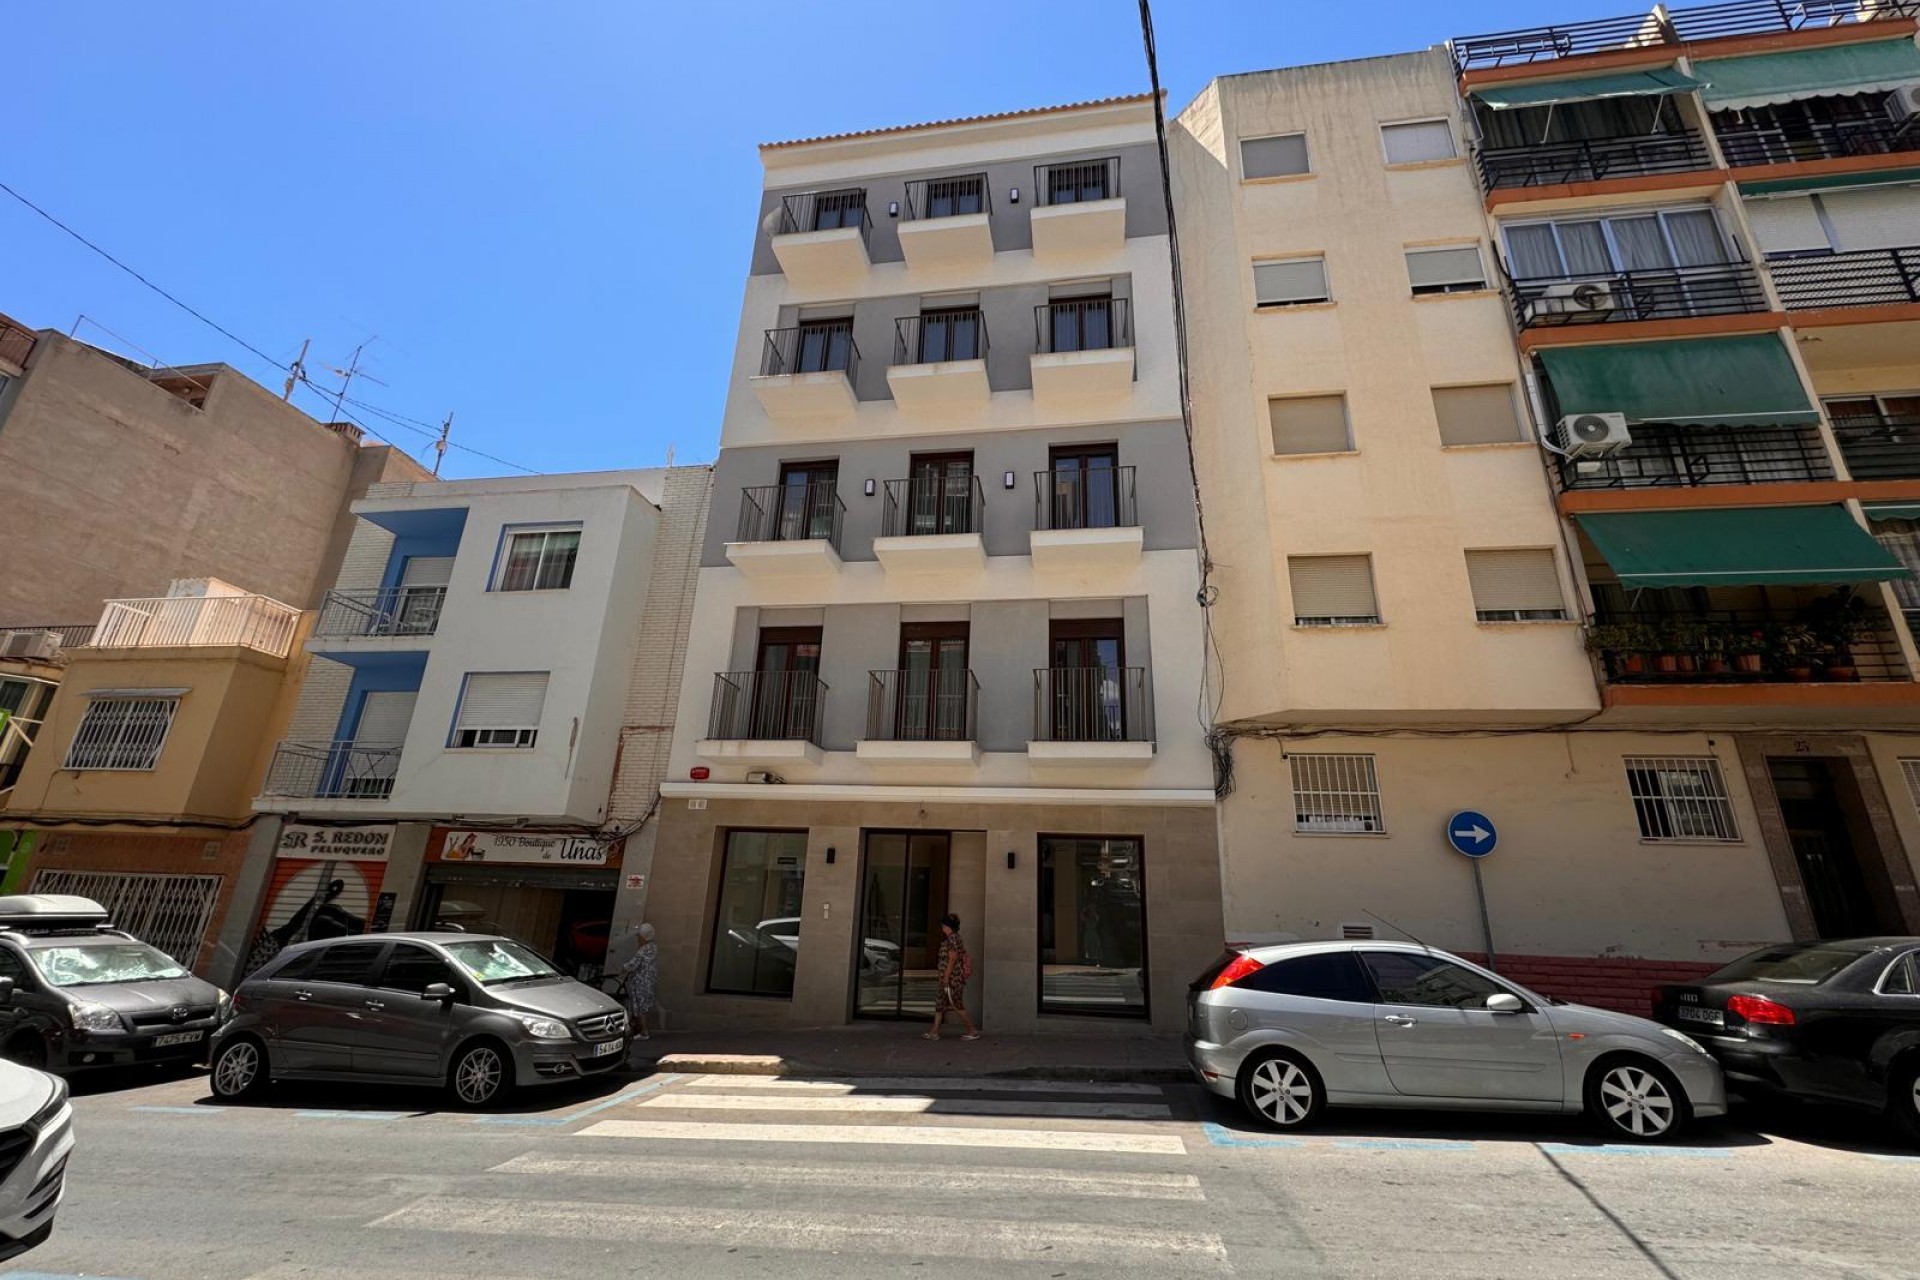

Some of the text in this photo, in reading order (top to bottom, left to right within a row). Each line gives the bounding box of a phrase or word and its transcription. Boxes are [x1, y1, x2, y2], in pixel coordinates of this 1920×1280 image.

[312, 831, 326, 844] S.
[518, 836, 555, 851] Boutique
[542, 852, 552, 860] de
[559, 838, 604, 861] Uñas
